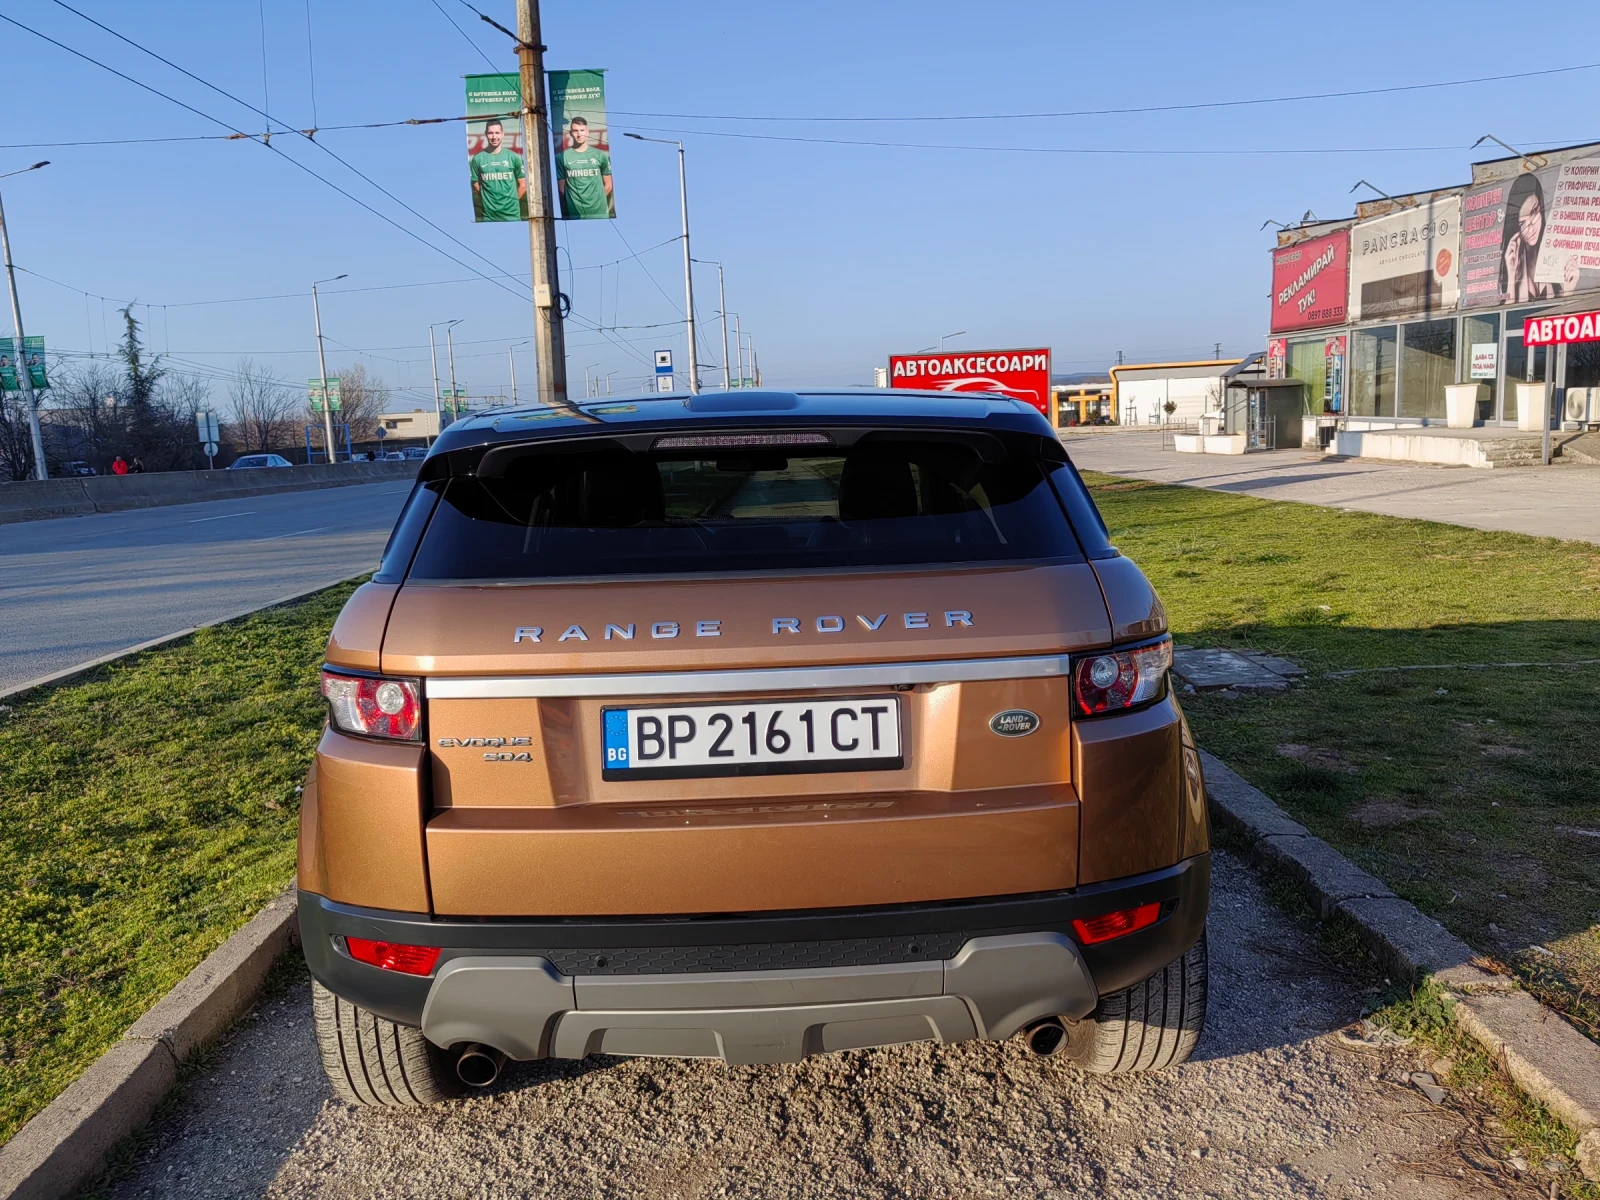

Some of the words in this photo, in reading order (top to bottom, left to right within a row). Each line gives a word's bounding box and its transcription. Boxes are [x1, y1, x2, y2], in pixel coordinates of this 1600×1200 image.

[481, 171, 513, 180] WINBET
[566, 168, 599, 178] WINBET
[1570, 165, 1600, 176] КОПИРНИ
[1564, 180, 1597, 191] ГРАФИЧЕН
[1465, 187, 1503, 212] КОПИРЕН
[1562, 195, 1590, 206] ПЕЧАТНА
[1465, 211, 1497, 233] ЦЕНТЪР
[1553, 224, 1585, 236] РЕКЛАМНИ
[1362, 219, 1449, 256] PANCRACIO
[1552, 238, 1583, 250] ФИРМЕНИ
[1379, 256, 1398, 265] ARTISAN
[1398, 250, 1426, 261] CHOCOLATE
[1278, 243, 1335, 307] РЕКЛАМИРАЙ
[1297, 288, 1316, 314] ТУК!
[1308, 310, 1320, 320] 0897
[1321, 308, 1332, 319] 888
[1333, 306, 1343, 317] 333
[893, 354, 1047, 377] АВТОАКСЕСОАРИ
[513, 620, 722, 643] RANGE
[772, 610, 974, 635] ROVER
[1000, 715, 1024, 724] LAND
[1002, 722, 1031, 731] ROVER
[636, 714, 697, 761] BP
[707, 709, 815, 758] 2161
[830, 706, 889, 752] CT
[438, 736, 532, 748] EVOQUE
[483, 752, 533, 762] SD4
[607, 747, 627, 762] BG
